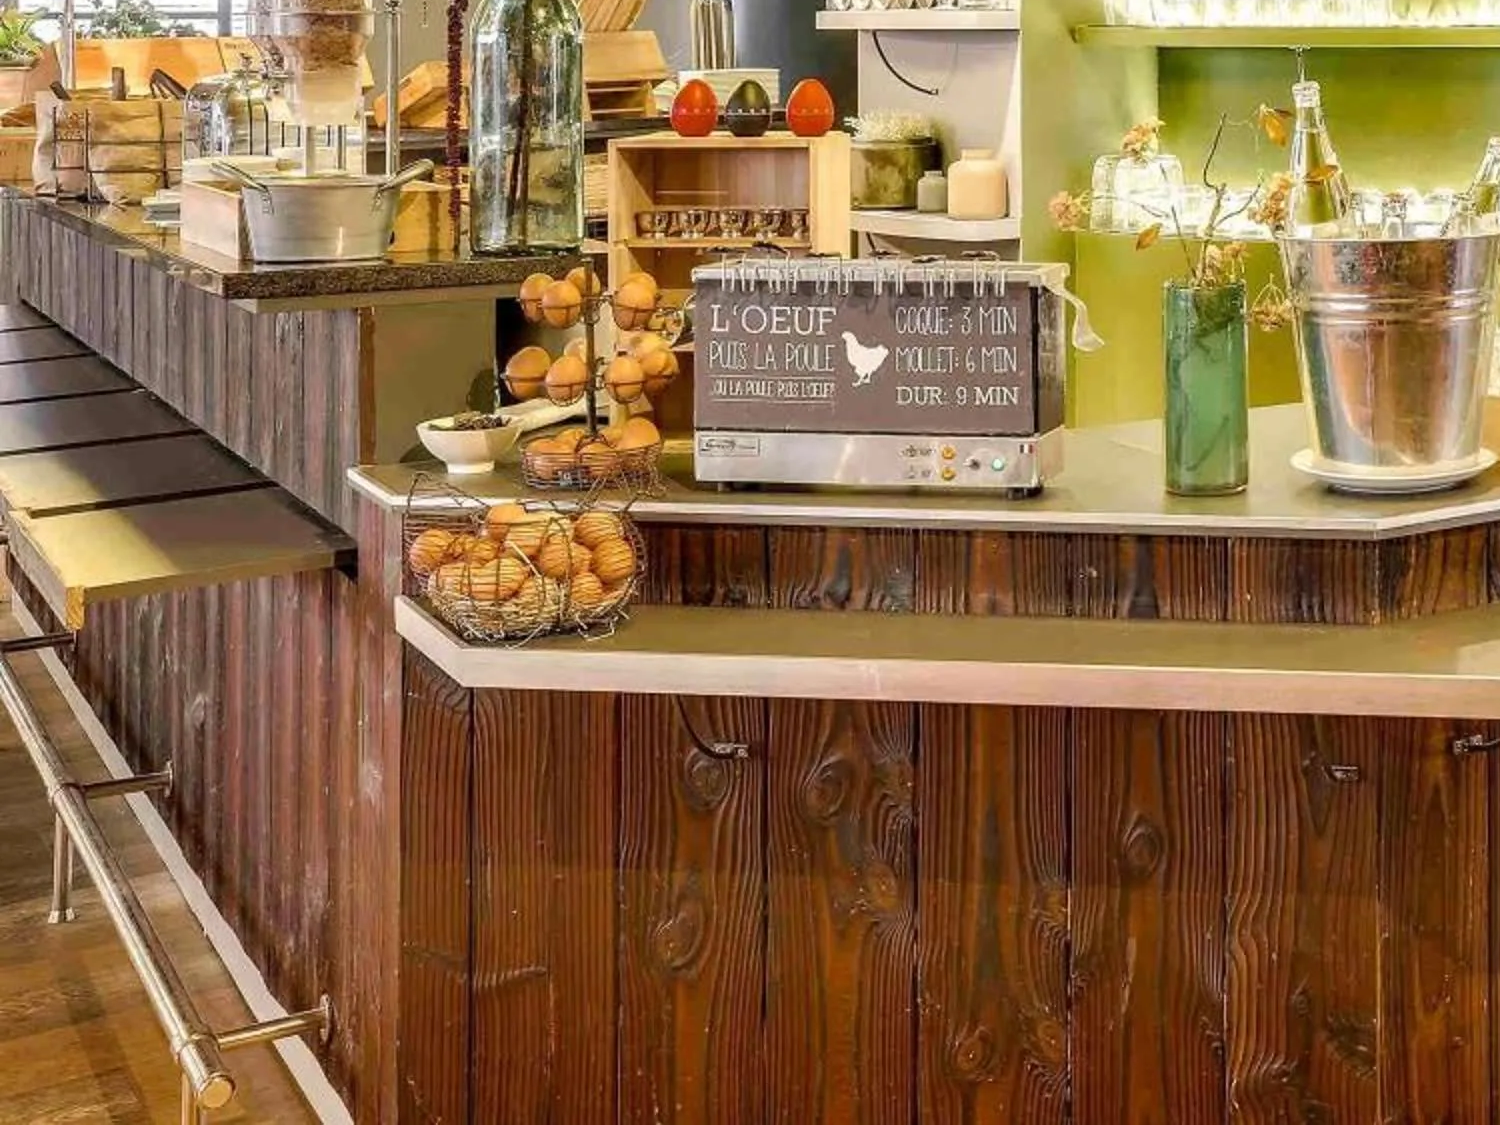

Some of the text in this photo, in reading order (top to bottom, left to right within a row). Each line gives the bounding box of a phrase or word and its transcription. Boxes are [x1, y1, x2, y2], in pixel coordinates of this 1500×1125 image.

[710, 304, 837, 335] L'OEUF
[895, 306, 1017, 335] COQUE: 3 MIN
[709, 340, 836, 372] PUIS LA POULE
[895, 346, 1018, 373] MOLLET: 6 MIN
[956, 386, 967, 406] 9
[974, 386, 1020, 406] MIN
